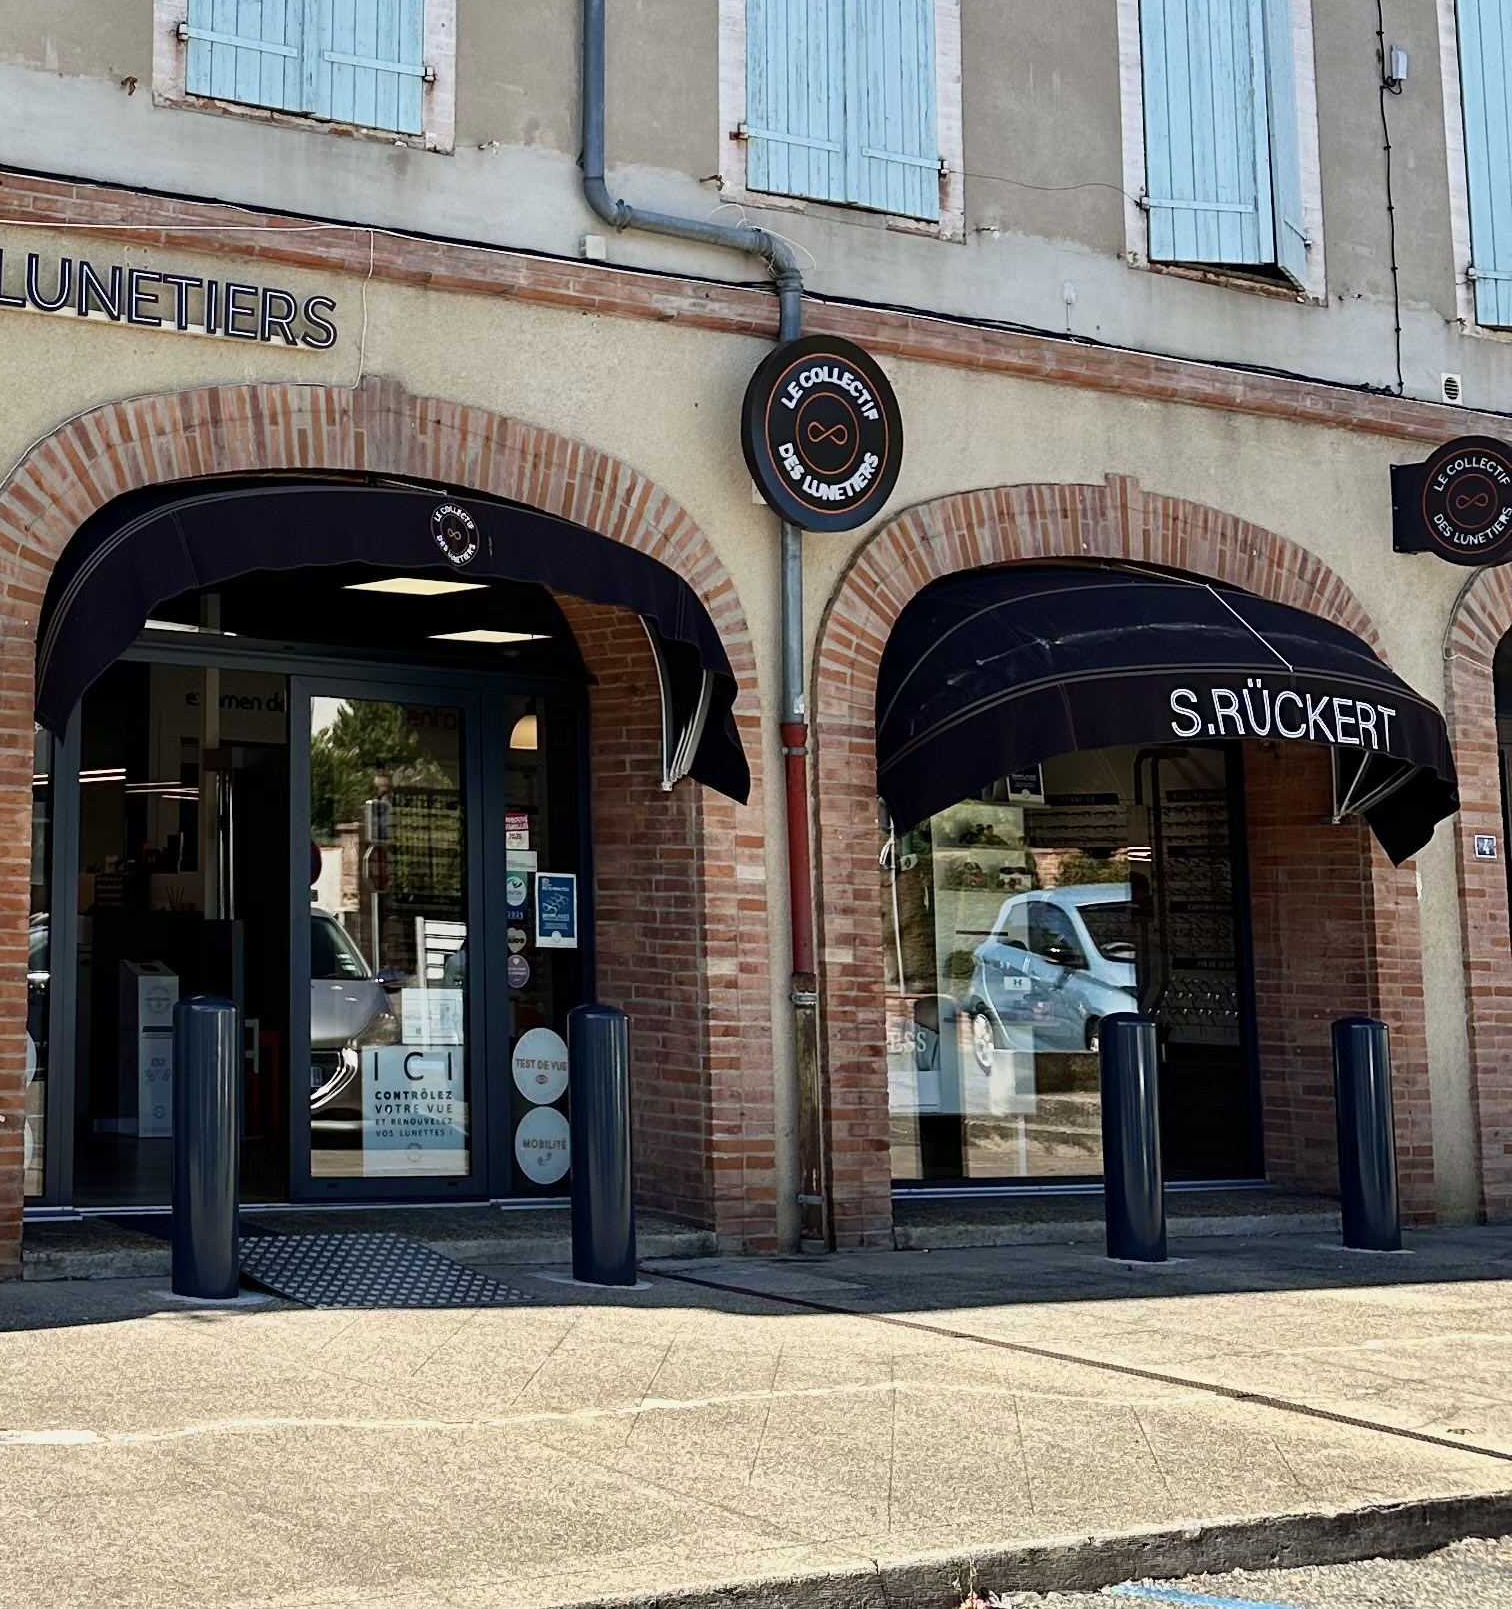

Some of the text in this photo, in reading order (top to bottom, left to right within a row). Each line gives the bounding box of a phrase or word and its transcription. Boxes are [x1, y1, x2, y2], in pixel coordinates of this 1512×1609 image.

[780, 365, 880, 421] LE COLLECTIF
[778, 442, 880, 501] DES LUNETIERS
[1433, 456, 1511, 492] LE COLLECTIF
[1433, 506, 1512, 546] DES LUNETIERS
[1170, 678, 1396, 752] S.RÜCKERT
[374, 1051, 453, 1081] ICI
[515, 1058, 568, 1072] TEST DE VUE
[374, 1088, 453, 1101] CONTRÔLEZ
[374, 1104, 453, 1115] VOTRE VUE
[522, 1138, 567, 1150] MOBILITÉ
